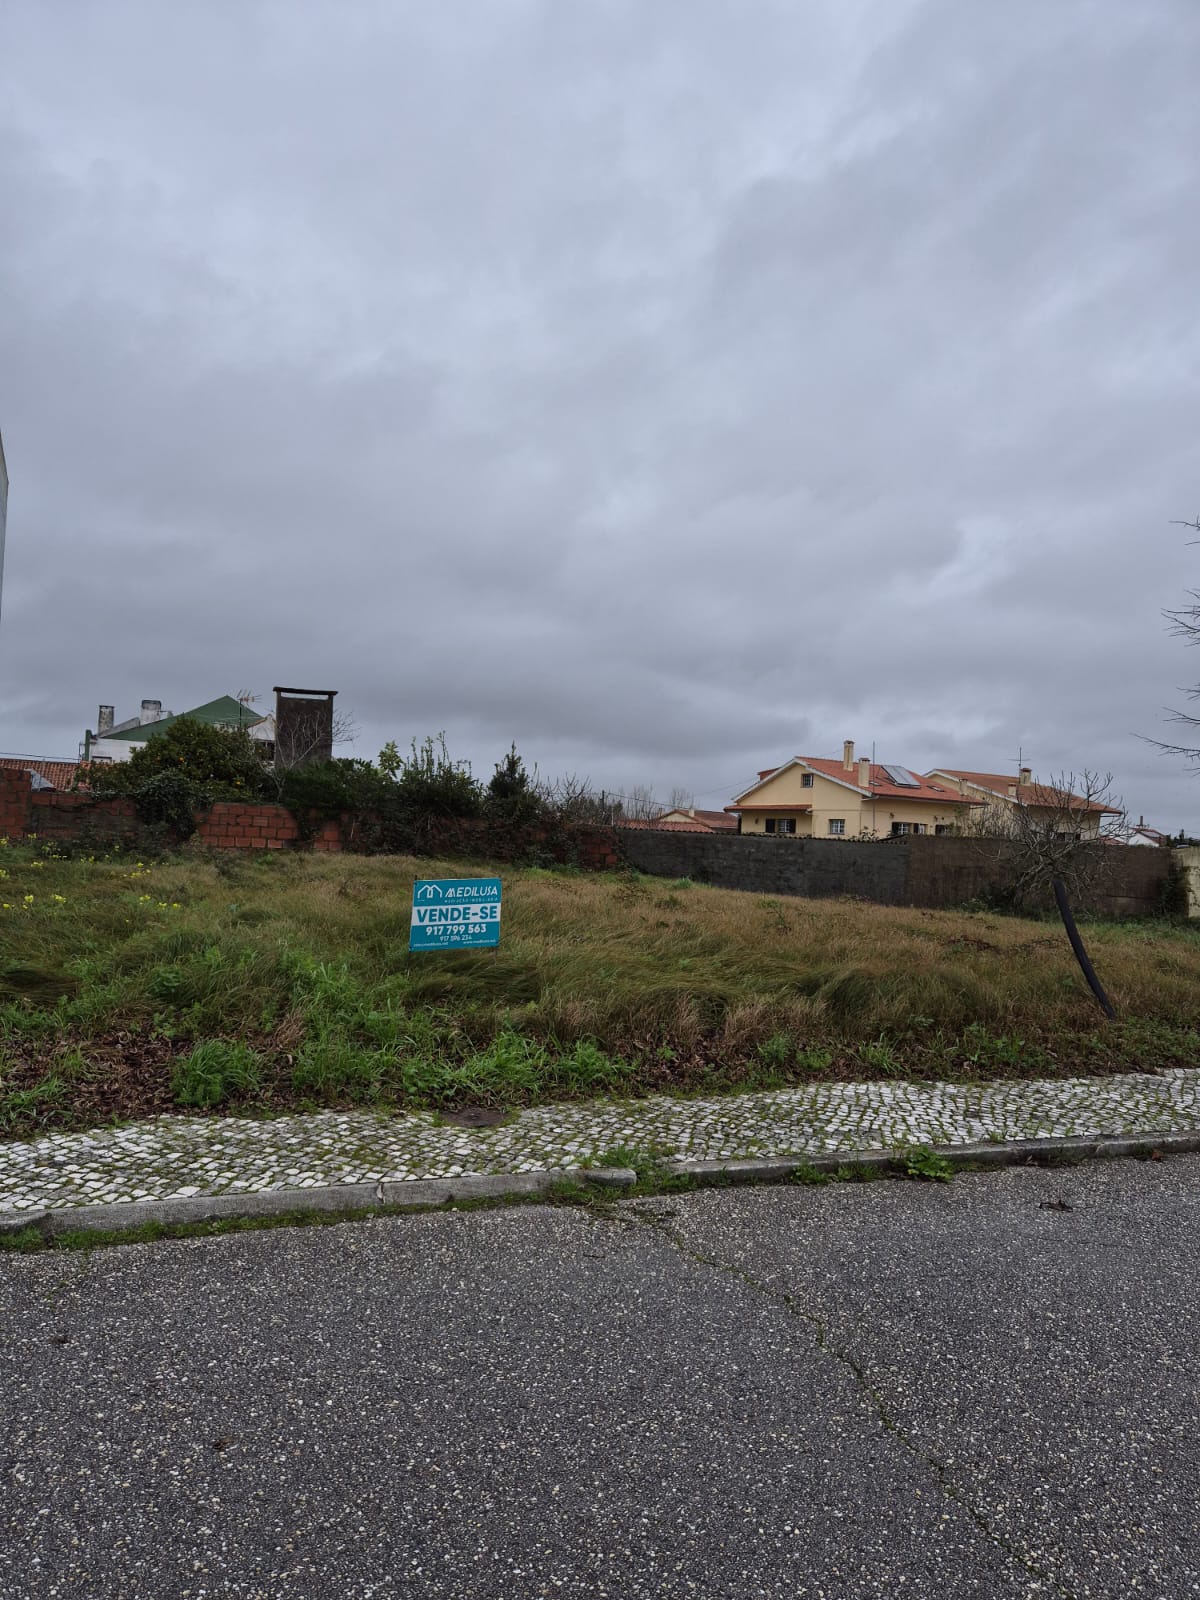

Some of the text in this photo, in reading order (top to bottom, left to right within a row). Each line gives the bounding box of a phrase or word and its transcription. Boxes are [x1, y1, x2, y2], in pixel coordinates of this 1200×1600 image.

[445, 886, 498, 898] MEDILUSA
[416, 905, 498, 923] VENDE-SE
[425, 923, 486, 936] 917 799 563
